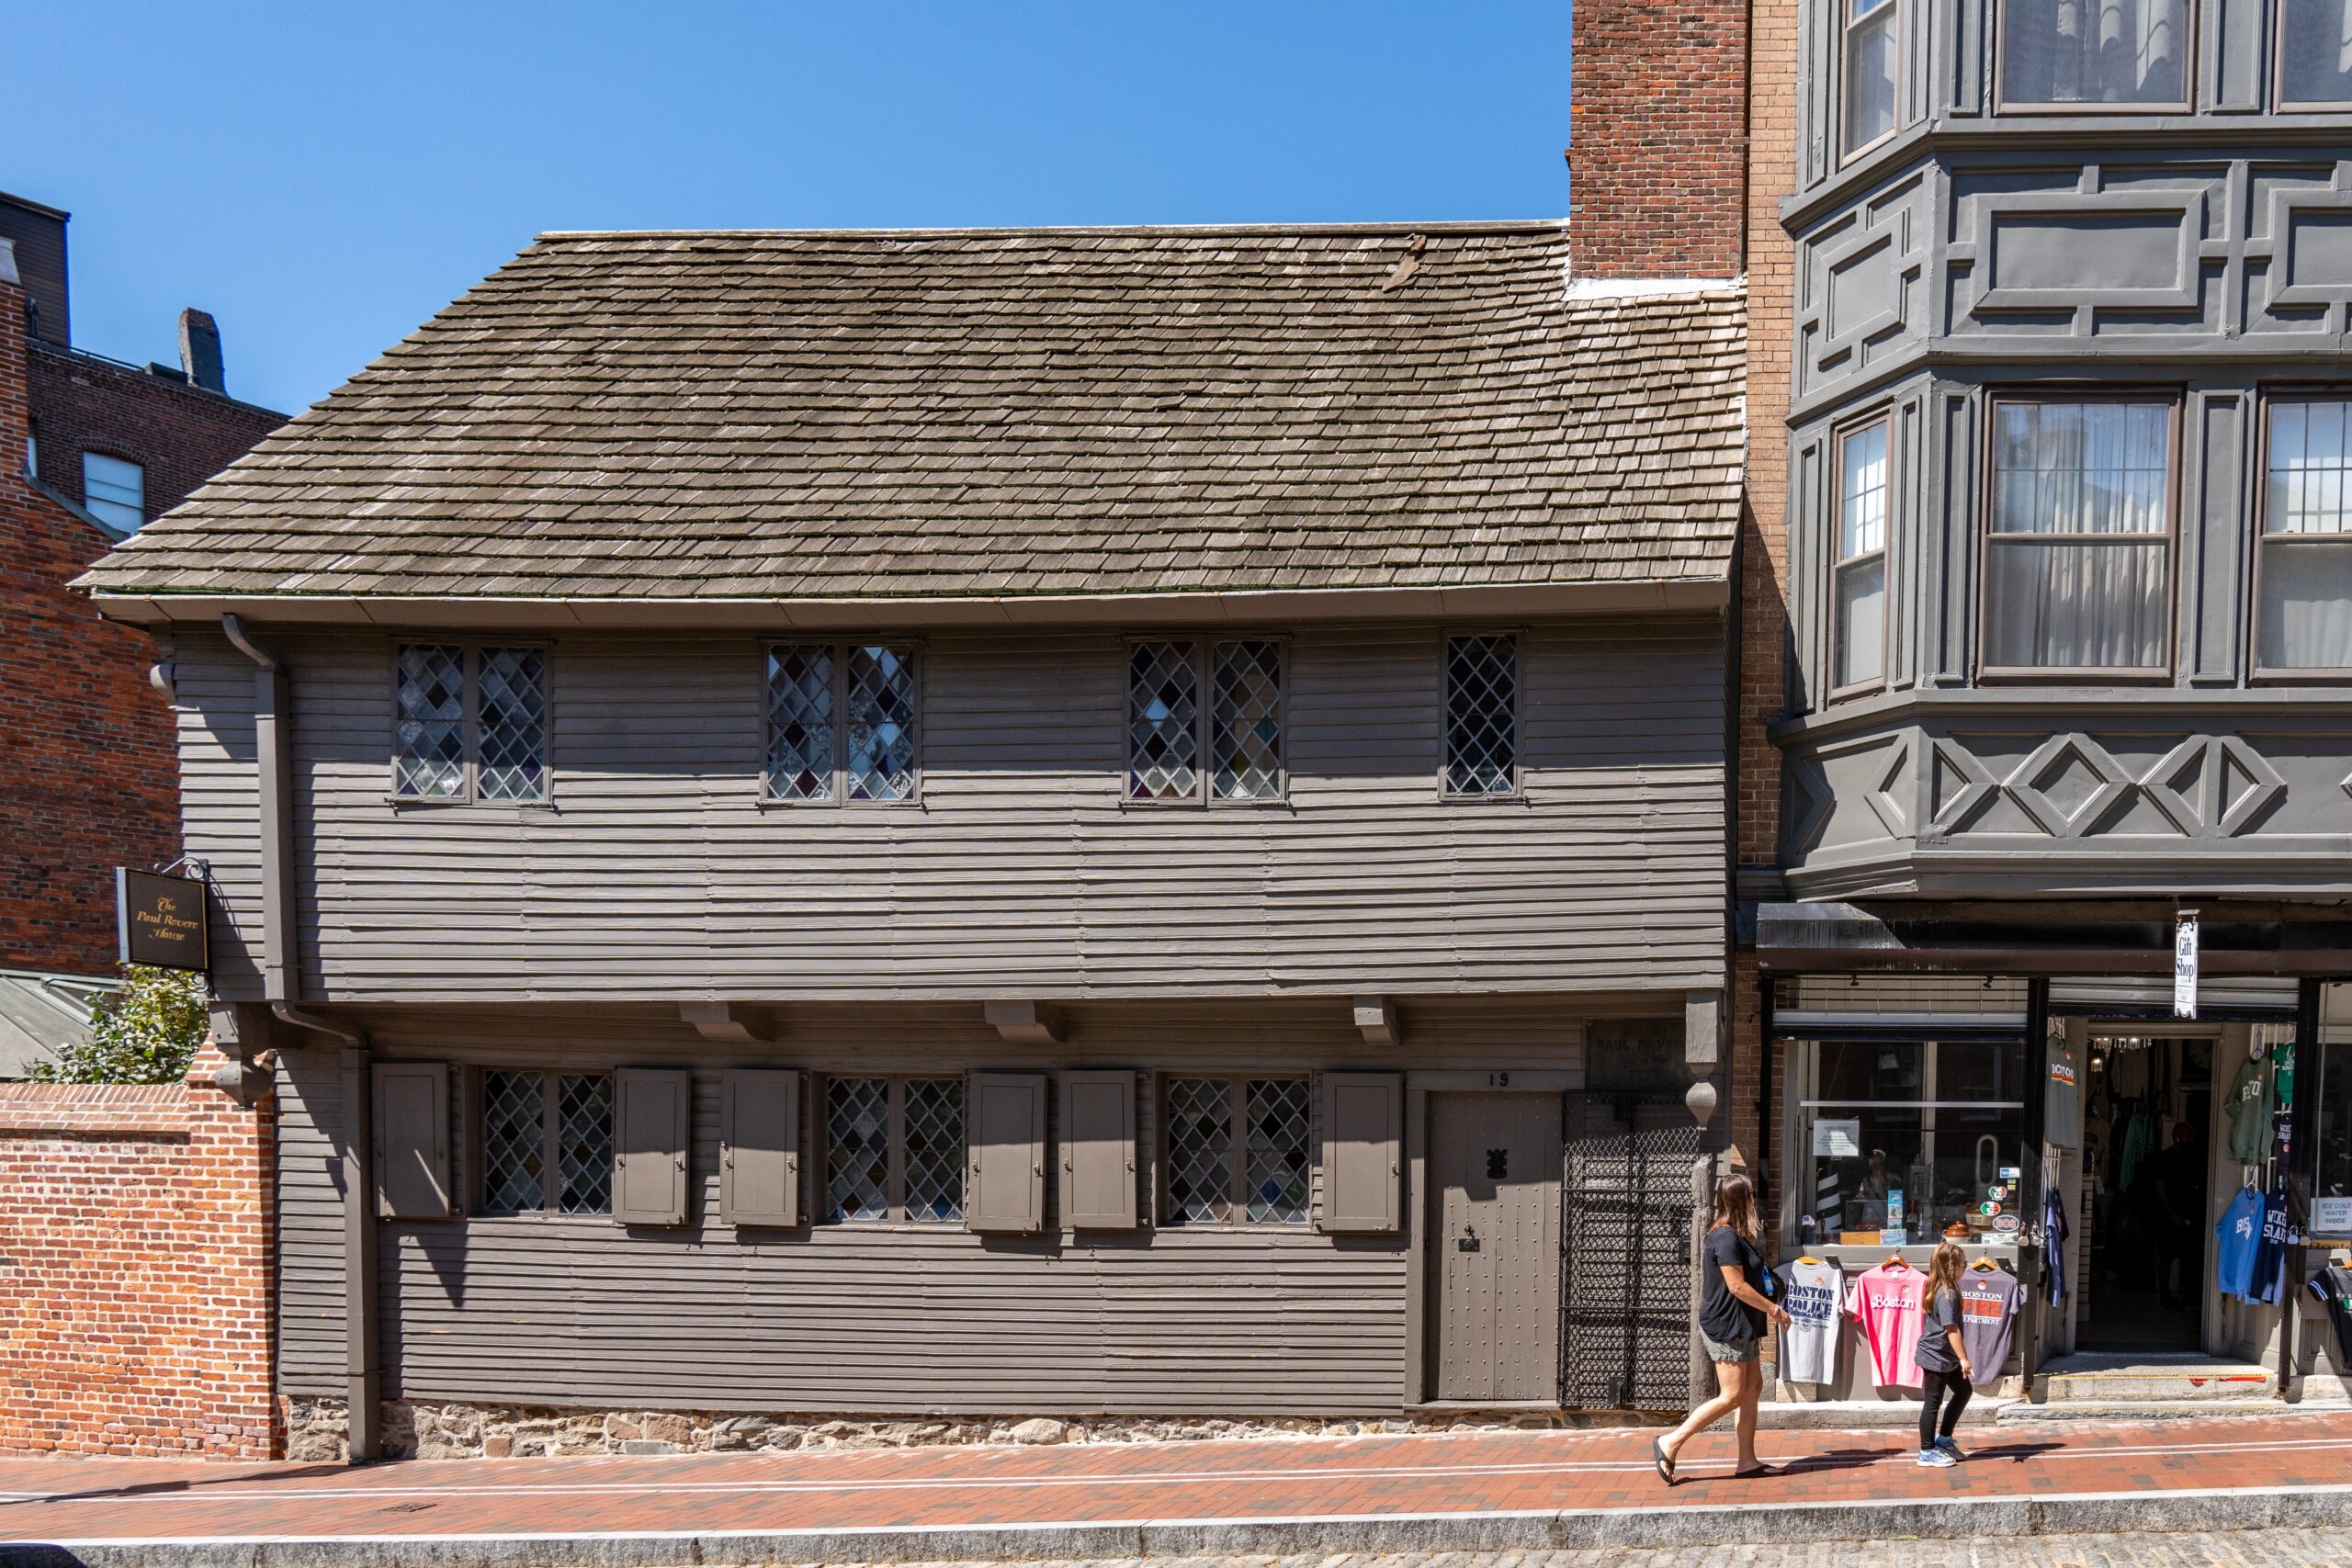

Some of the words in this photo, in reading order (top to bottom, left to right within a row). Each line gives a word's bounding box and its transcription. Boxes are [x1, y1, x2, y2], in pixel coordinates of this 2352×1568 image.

[157, 897, 177, 912] The
[137, 911, 162, 923] Paul
[164, 914, 198, 929] Revere
[148, 928, 186, 941] House
[2178, 937, 2192, 955] Gift
[2177, 958, 2194, 982] Shop
[1638, 1039, 1685, 1050] REVER
[1489, 1073, 1509, 1087] 19
[1996, 1219, 2017, 1228] BOS
[1785, 1284, 1834, 1301] BOSTON
[1962, 1291, 2003, 1300] BOSTON
[1783, 1297, 1833, 1316] POLICE
[1871, 1294, 1917, 1311] Boston
[1962, 1298, 2003, 1317] FIRE
[1962, 1315, 2000, 1325] EPARTMENT
